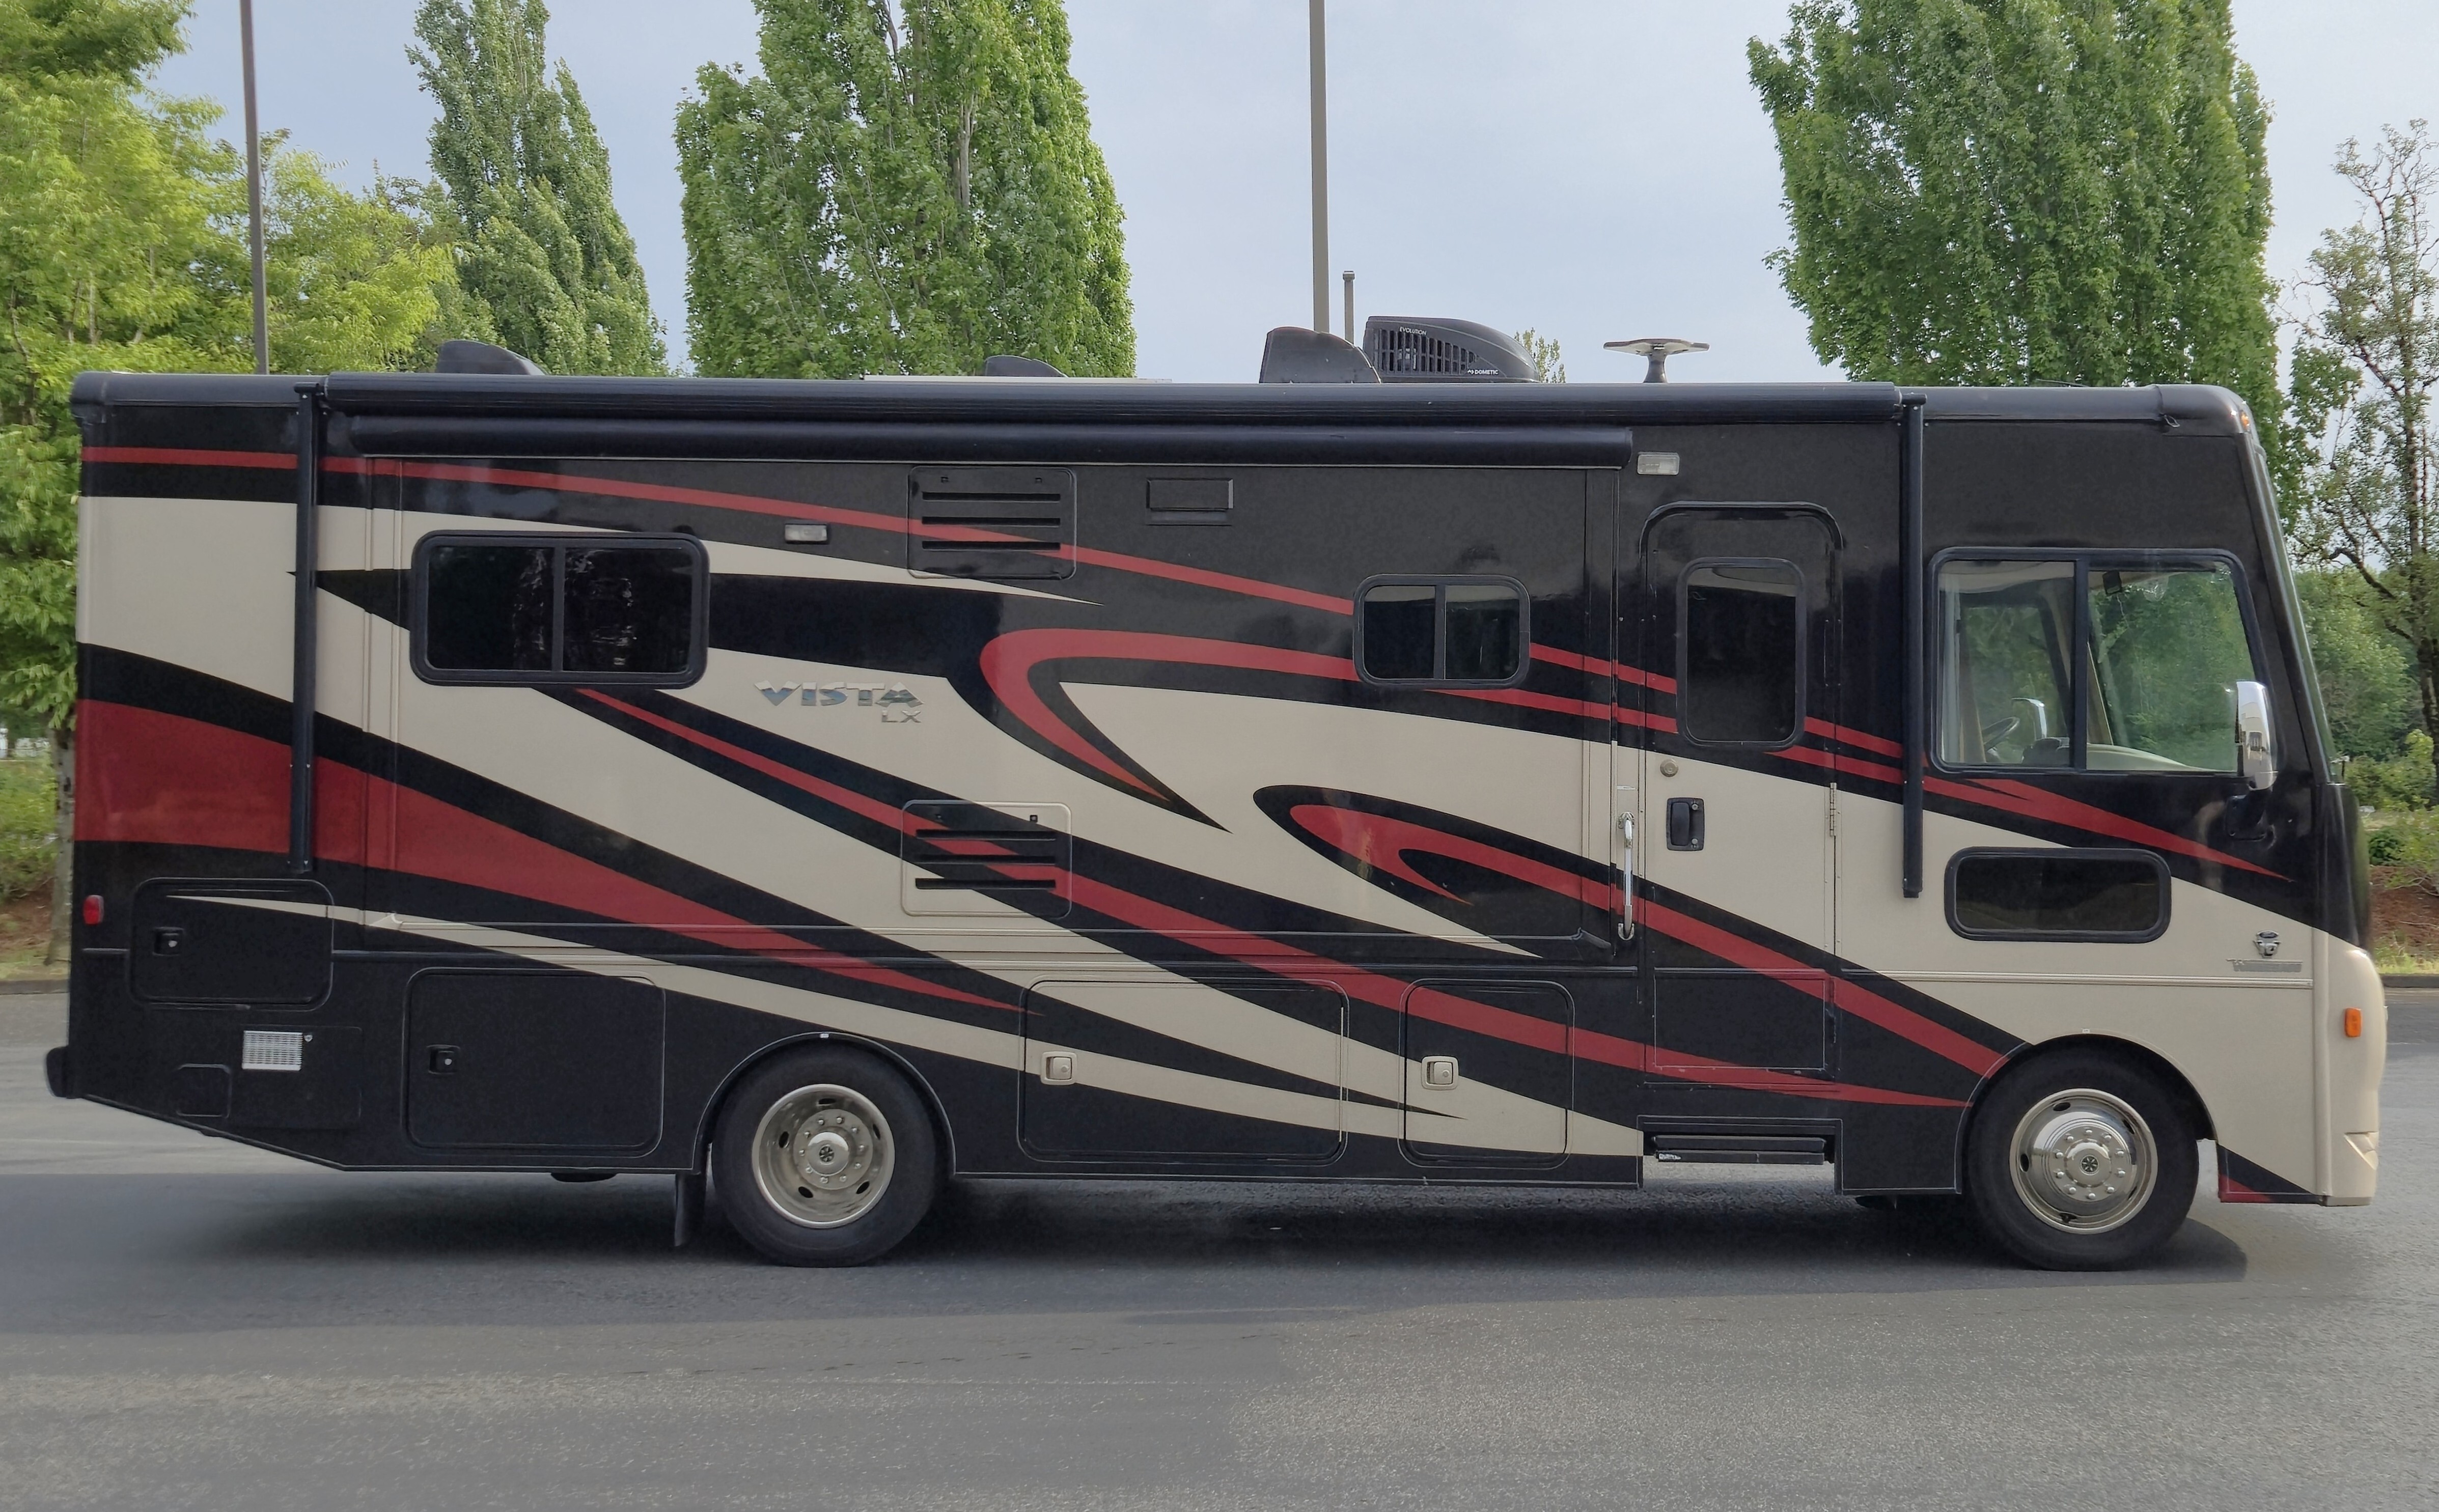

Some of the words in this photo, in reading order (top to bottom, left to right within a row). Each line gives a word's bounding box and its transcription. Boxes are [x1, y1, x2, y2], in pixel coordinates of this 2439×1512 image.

[1399, 326, 1427, 335] EVOLUTION
[754, 680, 925, 708] VISTA
[881, 710, 922, 723] LX
